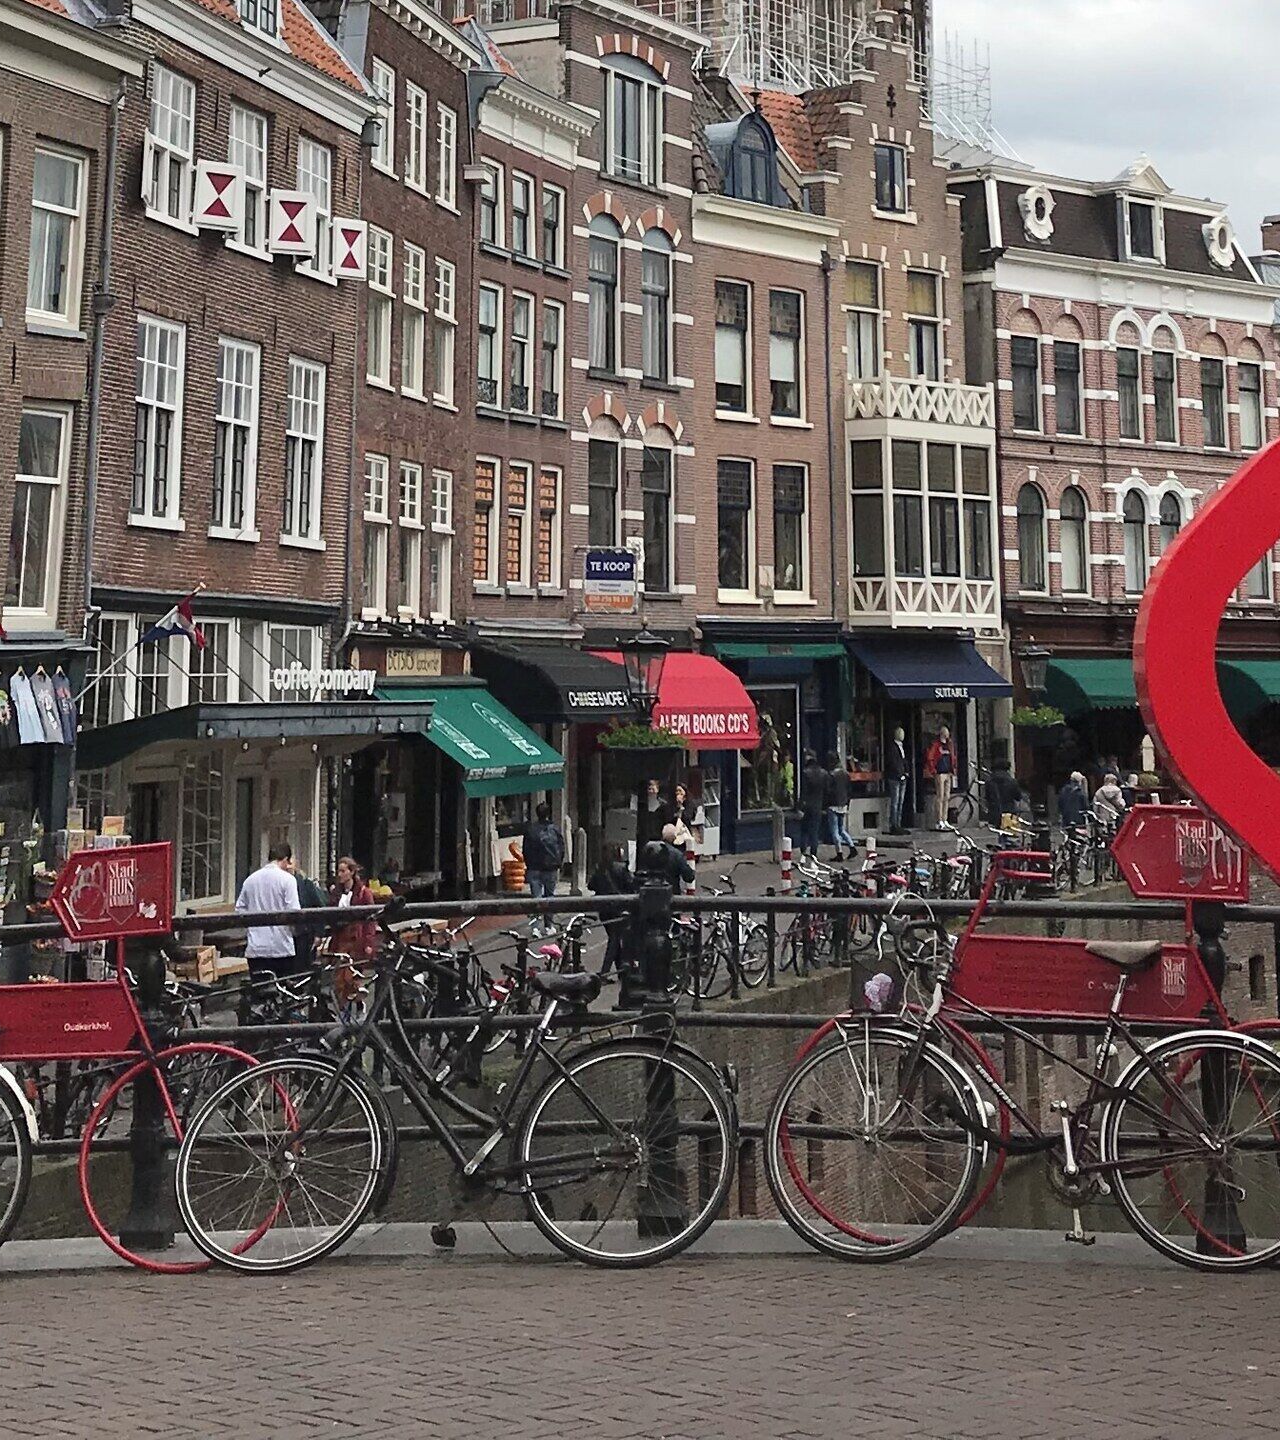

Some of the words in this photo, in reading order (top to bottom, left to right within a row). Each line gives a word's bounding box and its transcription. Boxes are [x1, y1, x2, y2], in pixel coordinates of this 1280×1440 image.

[590, 561, 602, 572] TE
[603, 561, 631, 572] KOOP
[934, 687, 969, 698] SUITABLE
[692, 713, 726, 735] BOOKS
[727, 713, 750, 734] CD'S
[109, 859, 134, 879] Stad
[109, 878, 135, 896] HUIS
